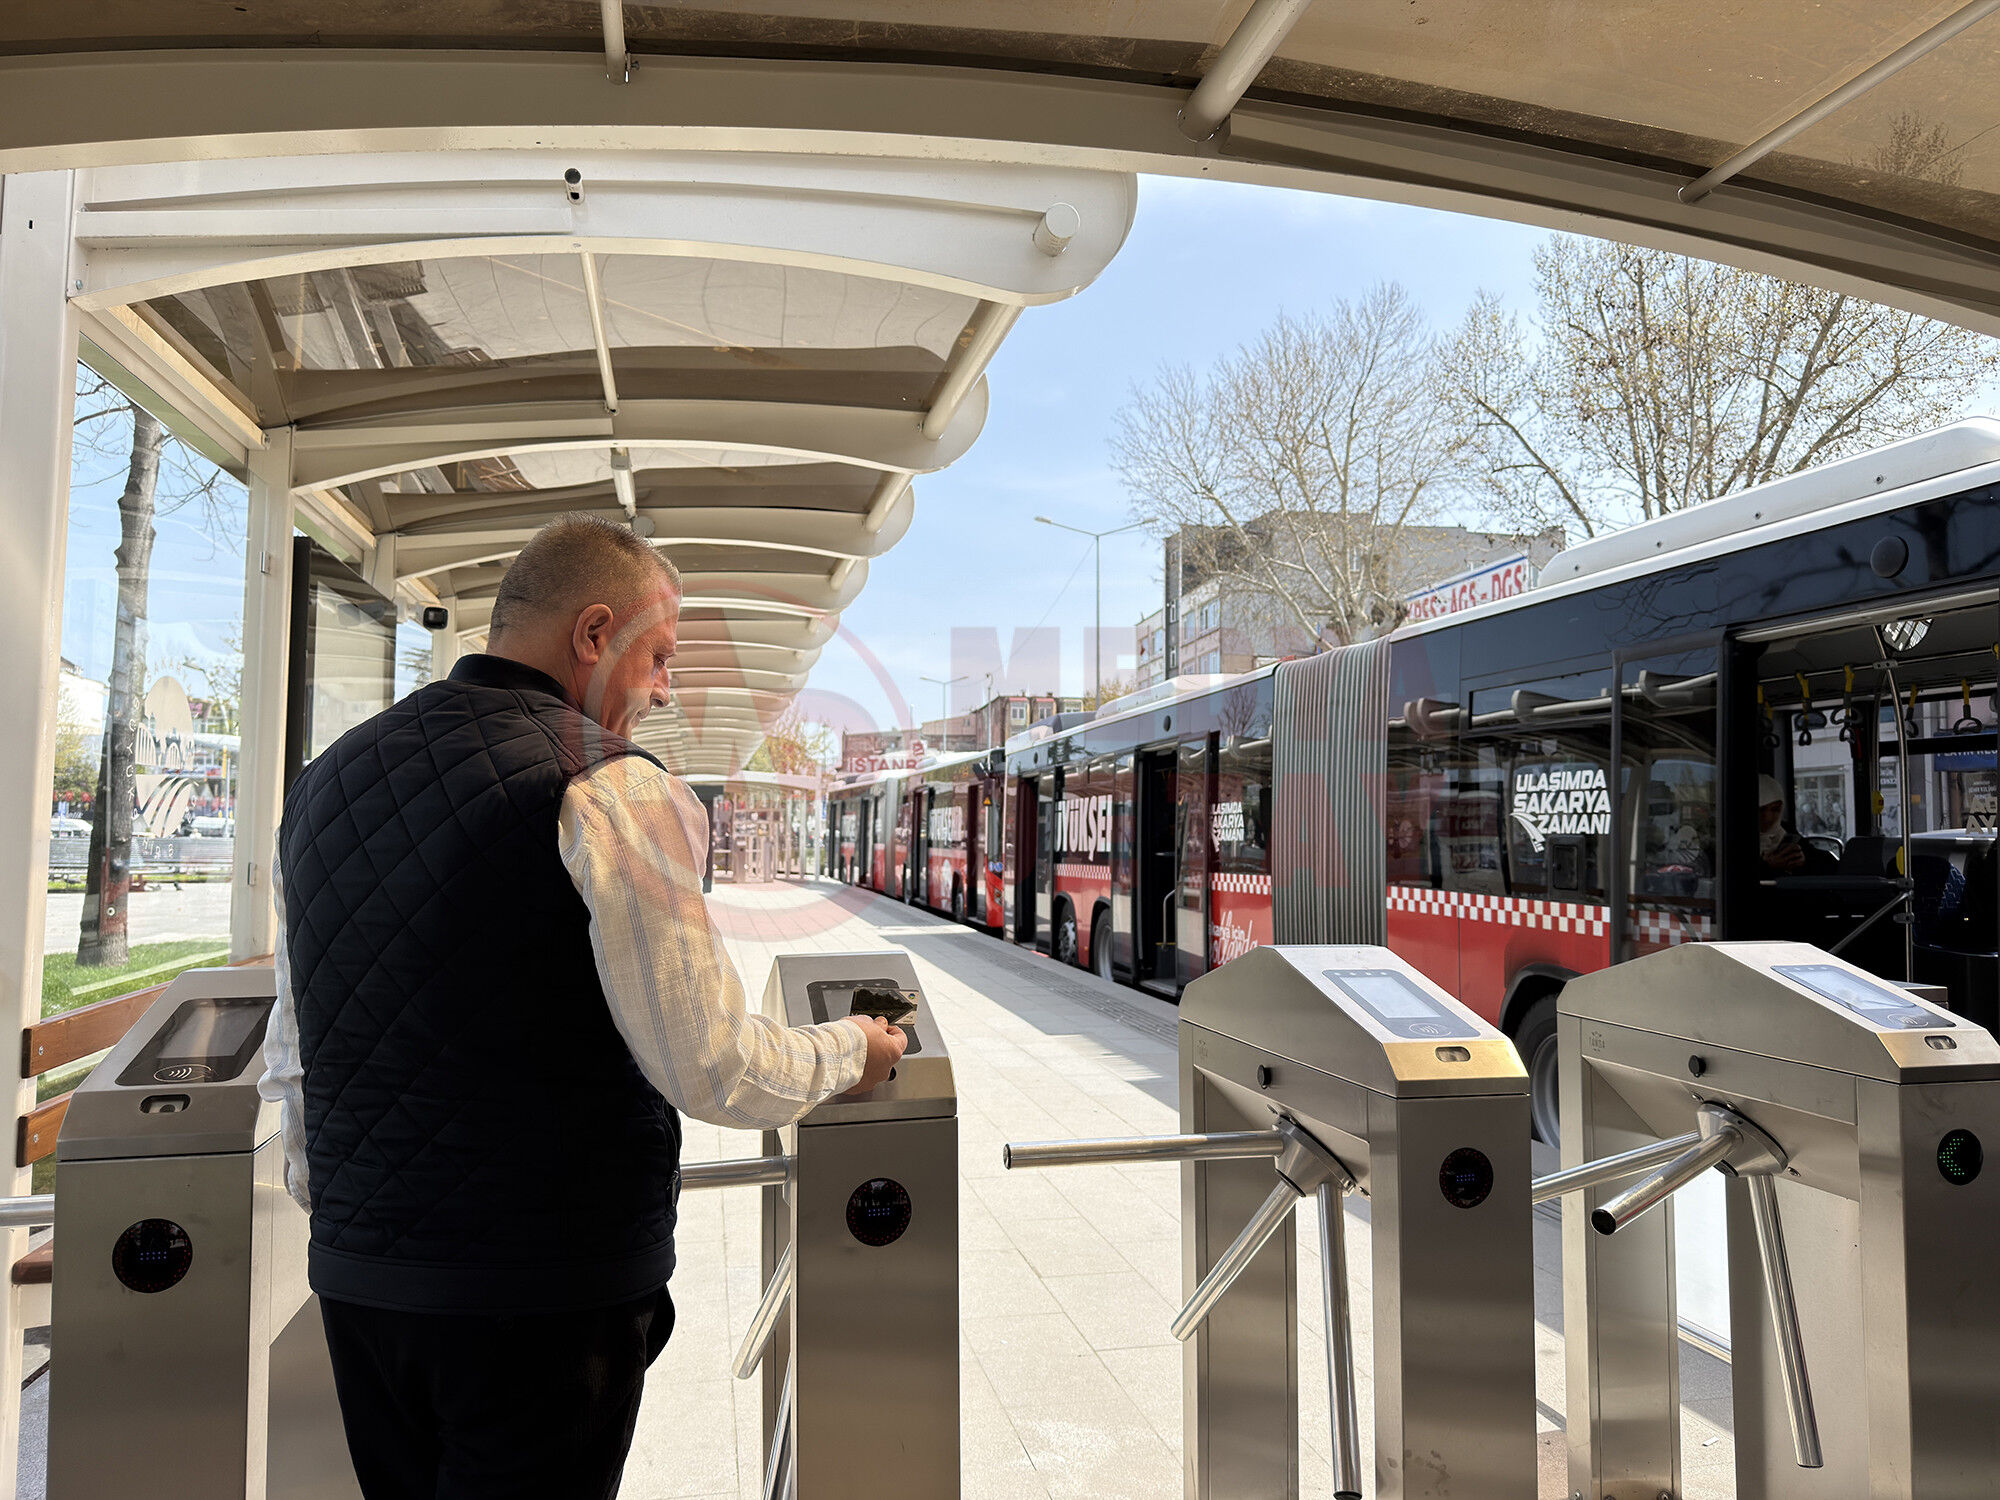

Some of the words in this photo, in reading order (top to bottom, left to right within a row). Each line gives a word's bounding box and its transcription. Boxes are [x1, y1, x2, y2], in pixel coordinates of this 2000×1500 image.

[1491, 565, 1523, 601] DGS
[1513, 789, 1612, 814] SAKARYA
[1054, 794, 1113, 862] ÜYÜKŞE
[1210, 813, 1245, 829] AKARYA
[1536, 813, 1612, 835] ZAMANI
